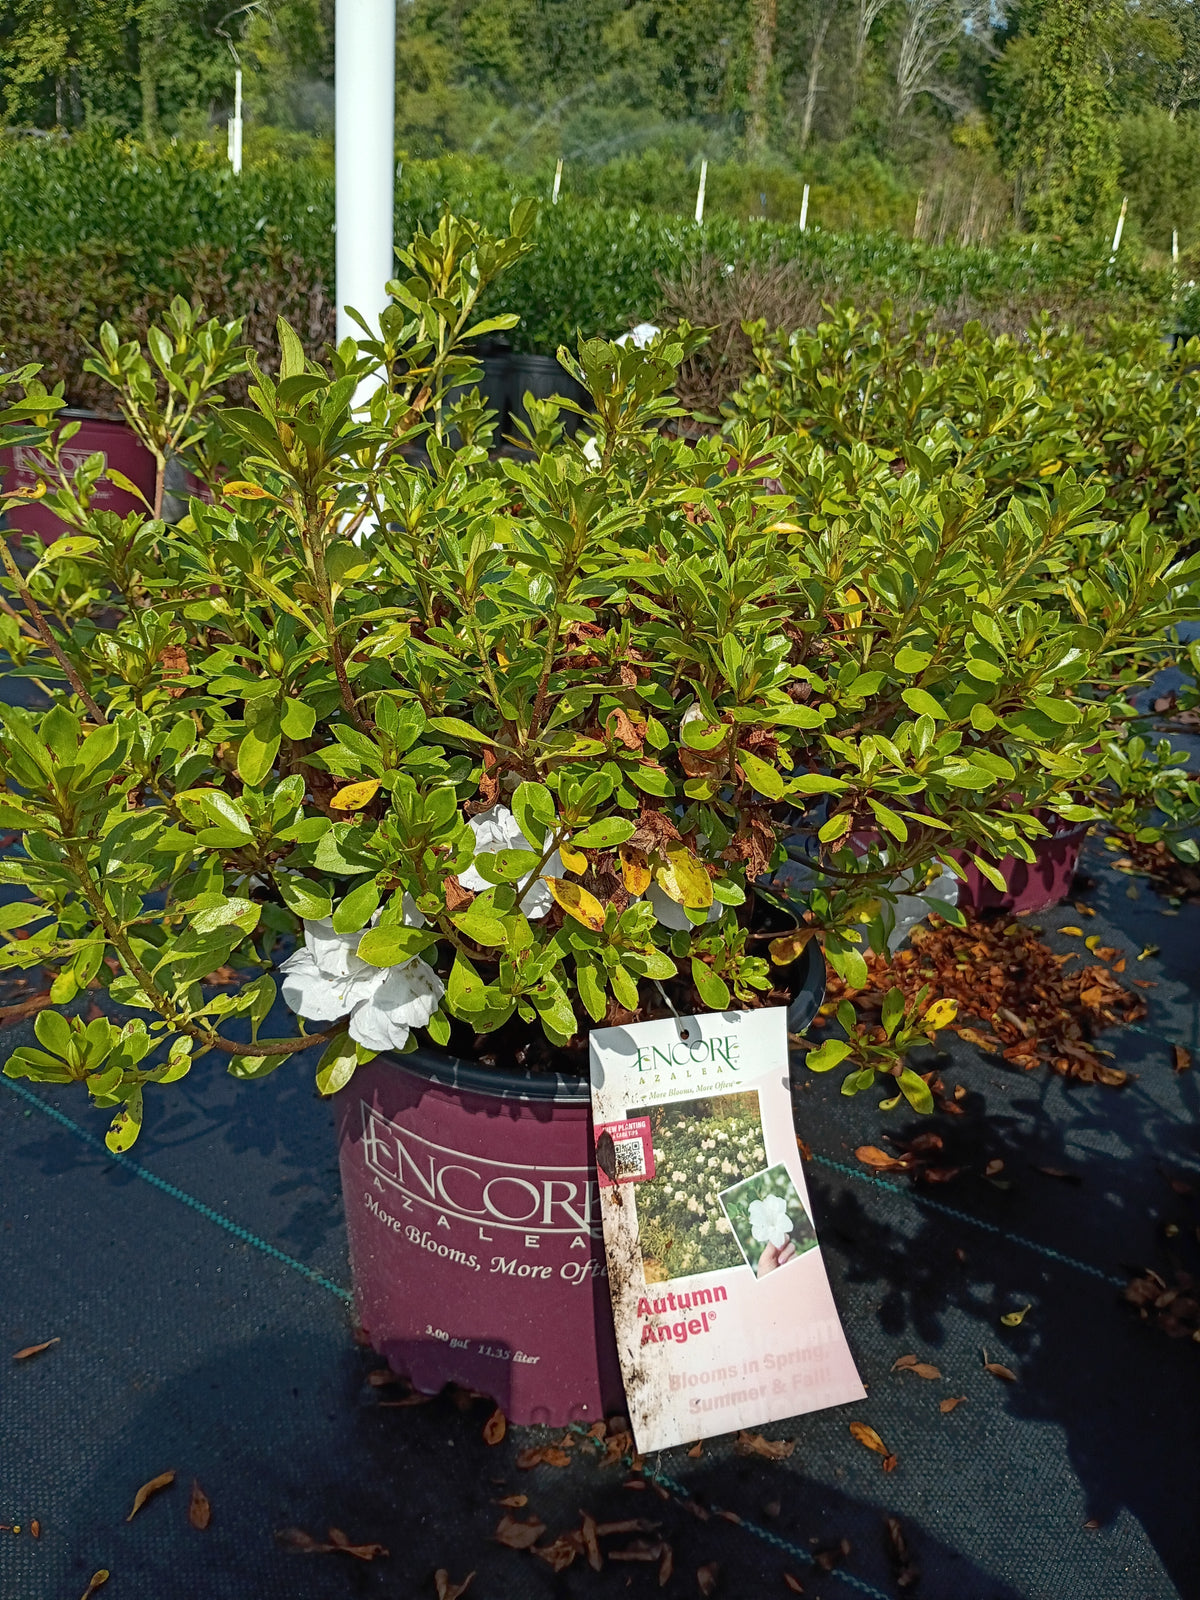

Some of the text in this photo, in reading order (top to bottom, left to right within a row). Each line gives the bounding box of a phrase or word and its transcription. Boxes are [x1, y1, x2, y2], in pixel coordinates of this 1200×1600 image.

[630, 1035, 740, 1072] ENCORE
[638, 1066, 723, 1085] AZALEA
[618, 1121, 646, 1132] PLANTING
[373, 1176, 586, 1248] AZALEA
[364, 1193, 402, 1232] More
[405, 1224, 481, 1271] Blooms,
[490, 1256, 552, 1279] More
[637, 1285, 727, 1318] Autumn
[425, 1324, 540, 1364] 3.00 gal 11.35 liter
[669, 1366, 738, 1392] Blooms
[743, 1359, 759, 1375] in
[689, 1384, 767, 1415] Summer
[772, 1378, 788, 1395] &
